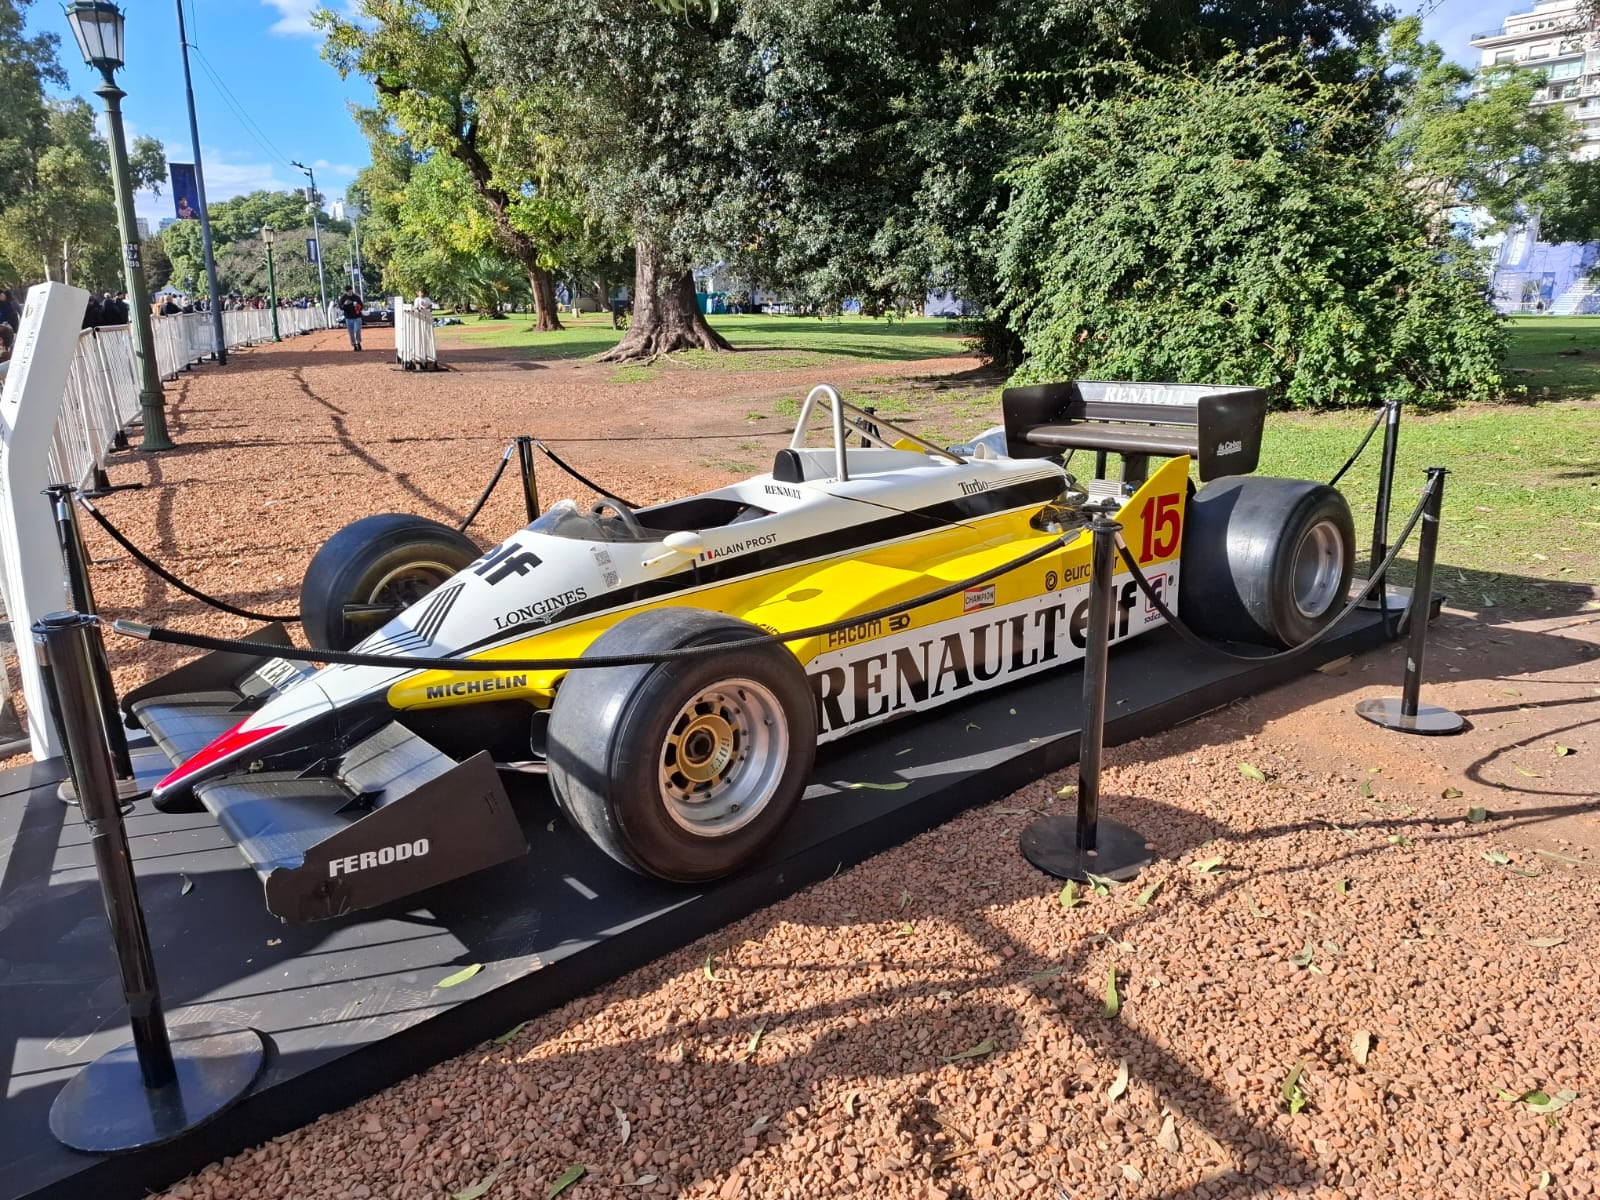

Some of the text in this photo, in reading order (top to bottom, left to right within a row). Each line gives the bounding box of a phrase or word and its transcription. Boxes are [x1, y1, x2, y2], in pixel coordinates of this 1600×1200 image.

[380, 311, 388, 321] 2
[1104, 386, 1185, 406] RENAULT
[764, 485, 801, 500] RENAULT
[958, 479, 989, 496] Turbo
[1138, 493, 1181, 563] 15
[713, 533, 777, 559] ALAIN PROST
[494, 587, 588, 630] LONGINES
[965, 590, 994, 605] CHAMPION
[828, 619, 882, 648] FACOM
[807, 603, 1066, 735] RENAULT
[426, 674, 527, 700] MICHELIN
[328, 838, 430, 878] FERODO
